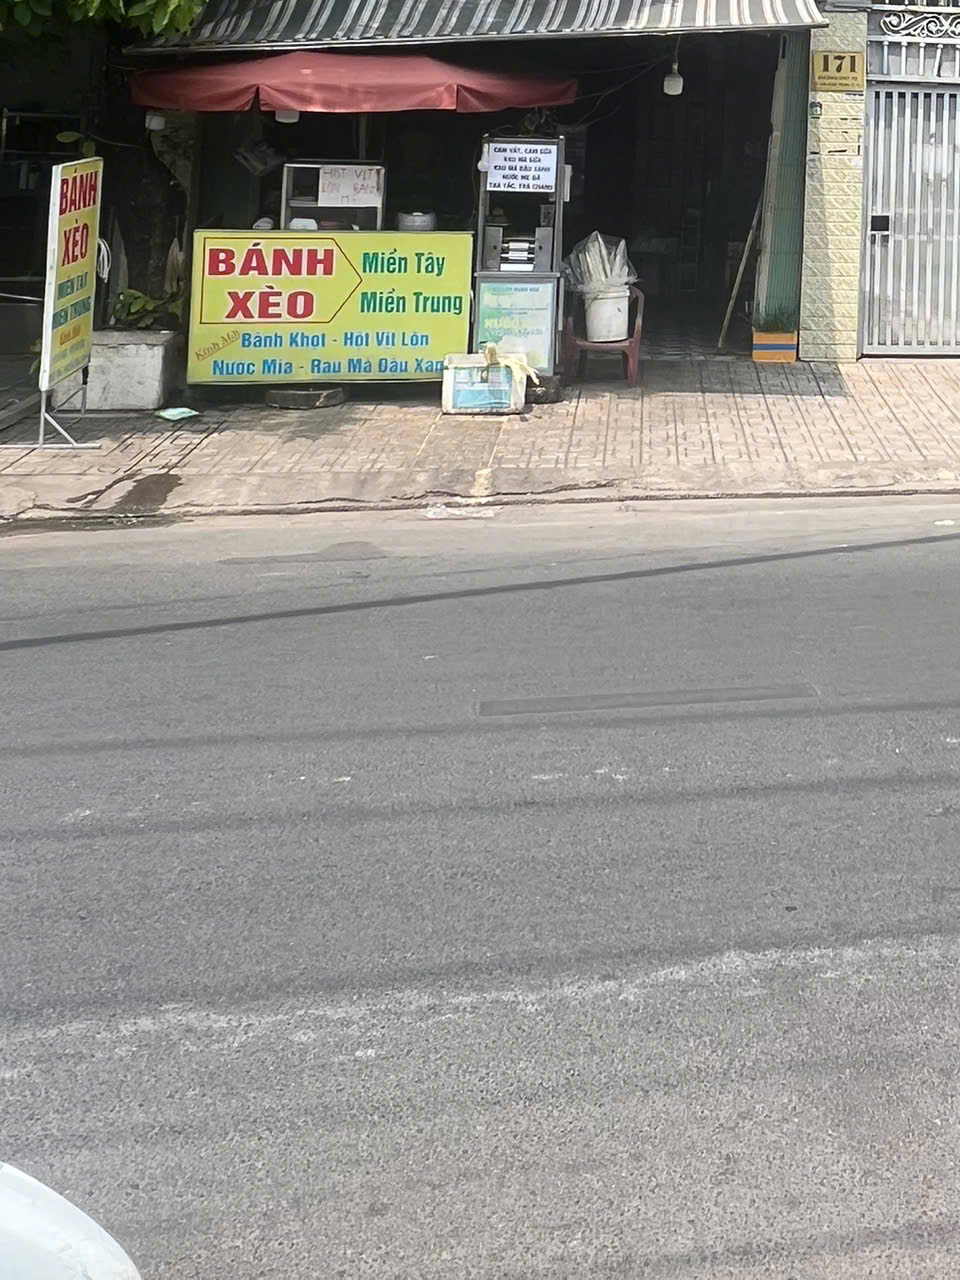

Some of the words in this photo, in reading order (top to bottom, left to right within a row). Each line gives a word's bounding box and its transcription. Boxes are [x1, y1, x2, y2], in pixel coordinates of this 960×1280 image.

[823, 55, 857, 73] 171
[59, 168, 97, 216] BÁNH
[62, 219, 89, 266] XÈO
[208, 242, 334, 276] BÁNH
[362, 248, 408, 274] Miền
[415, 252, 445, 276] Tây
[225, 285, 314, 319] XÈO
[360, 288, 406, 313] Miền
[413, 292, 463, 316] Trung
[241, 332, 283, 348] Bánh
[311, 358, 341, 373] Rau
[415, 358, 444, 373] Xan
